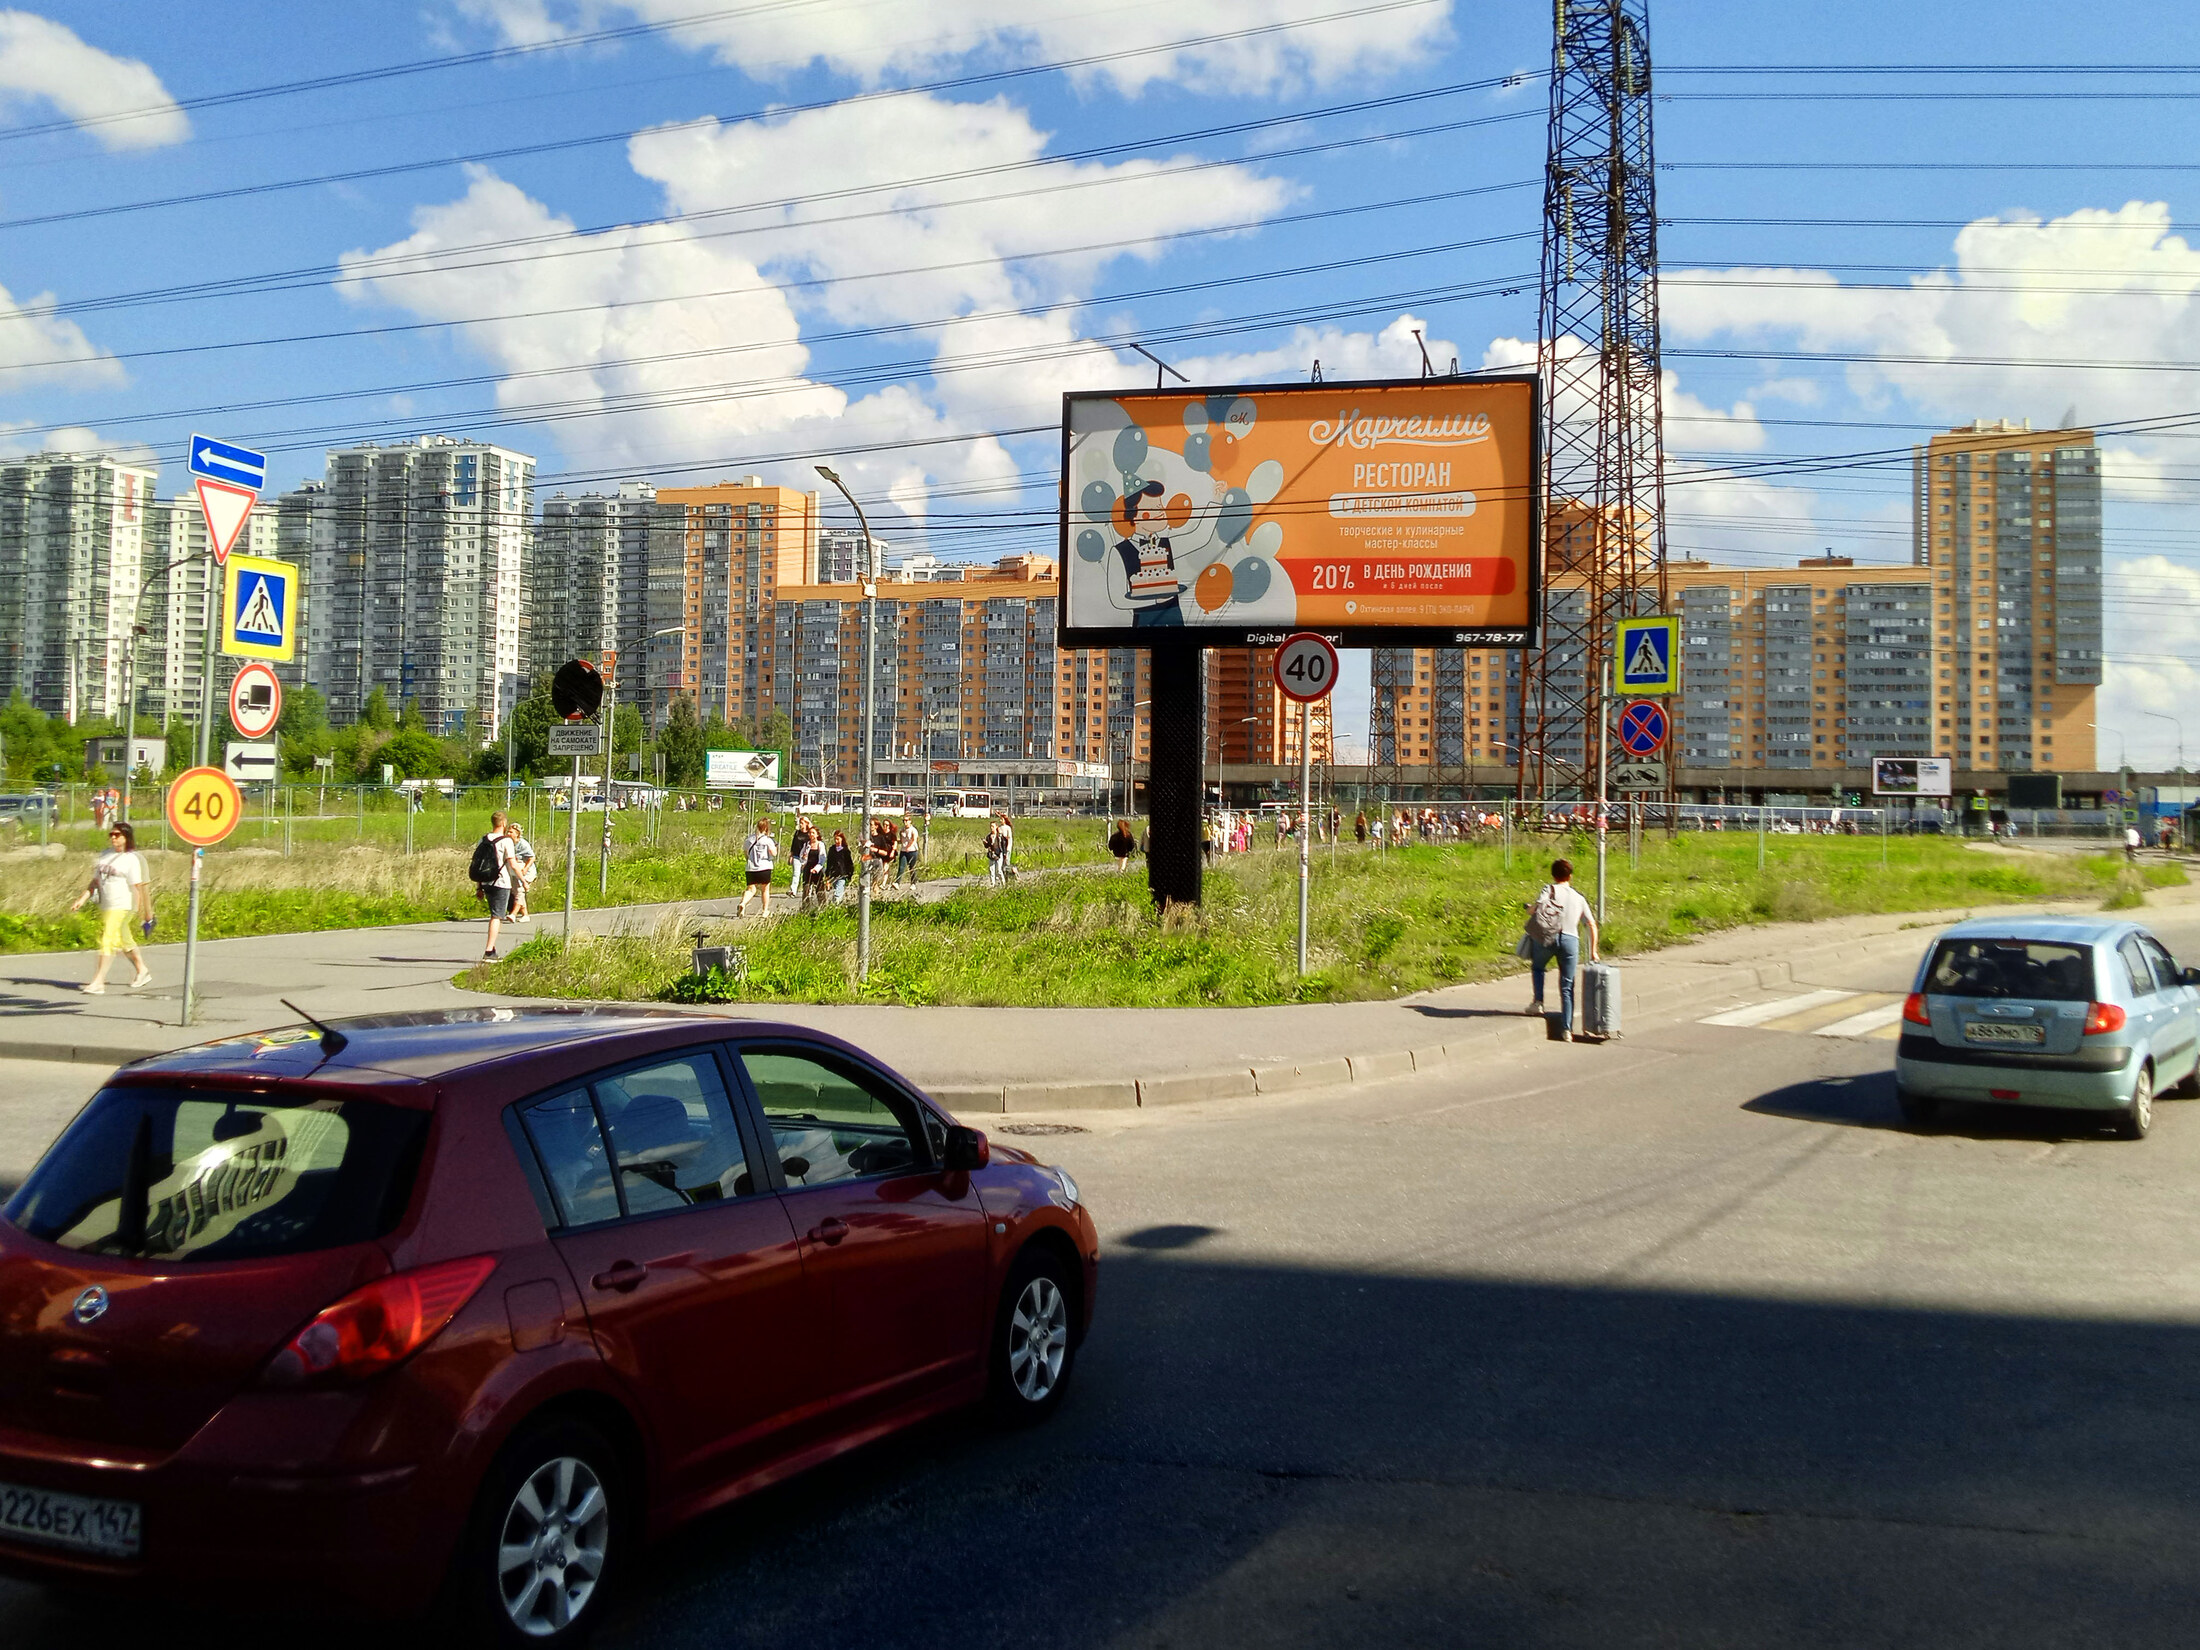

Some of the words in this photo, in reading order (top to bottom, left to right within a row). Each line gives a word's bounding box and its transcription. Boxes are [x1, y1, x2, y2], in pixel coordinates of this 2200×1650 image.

[1353, 461, 1451, 488] РЕСТОРАН
[1342, 499, 1350, 513] С
[1352, 497, 1401, 514] ДЕТСКОЙ
[1405, 495, 1464, 513] КОМНАТОЙ
[1339, 526, 1393, 537] творческие
[1396, 526, 1402, 536] и
[1405, 525, 1465, 538] кулинарные
[1364, 539, 1439, 551] мастер-классы
[1312, 564, 1355, 590] 20%
[1363, 564, 1371, 579] В
[1374, 563, 1405, 580] ДЕНЬ
[1408, 563, 1472, 580] РОЖДЕНИЯ
[1398, 582, 1417, 590] дней
[1246, 633, 1286, 645] Digital
[1455, 632, 1524, 643] 967-78-77
[1285, 654, 1325, 682] 40
[555, 729, 593, 737] ДВИЖЕНИЕ
[550, 736, 560, 744] НА
[561, 736, 597, 744] САМОКАТЕ
[552, 744, 595, 752] ЗАПРЕЩЕНО
[183, 791, 224, 821] 40
[0, 1489, 88, 1538] 226ЕХ
